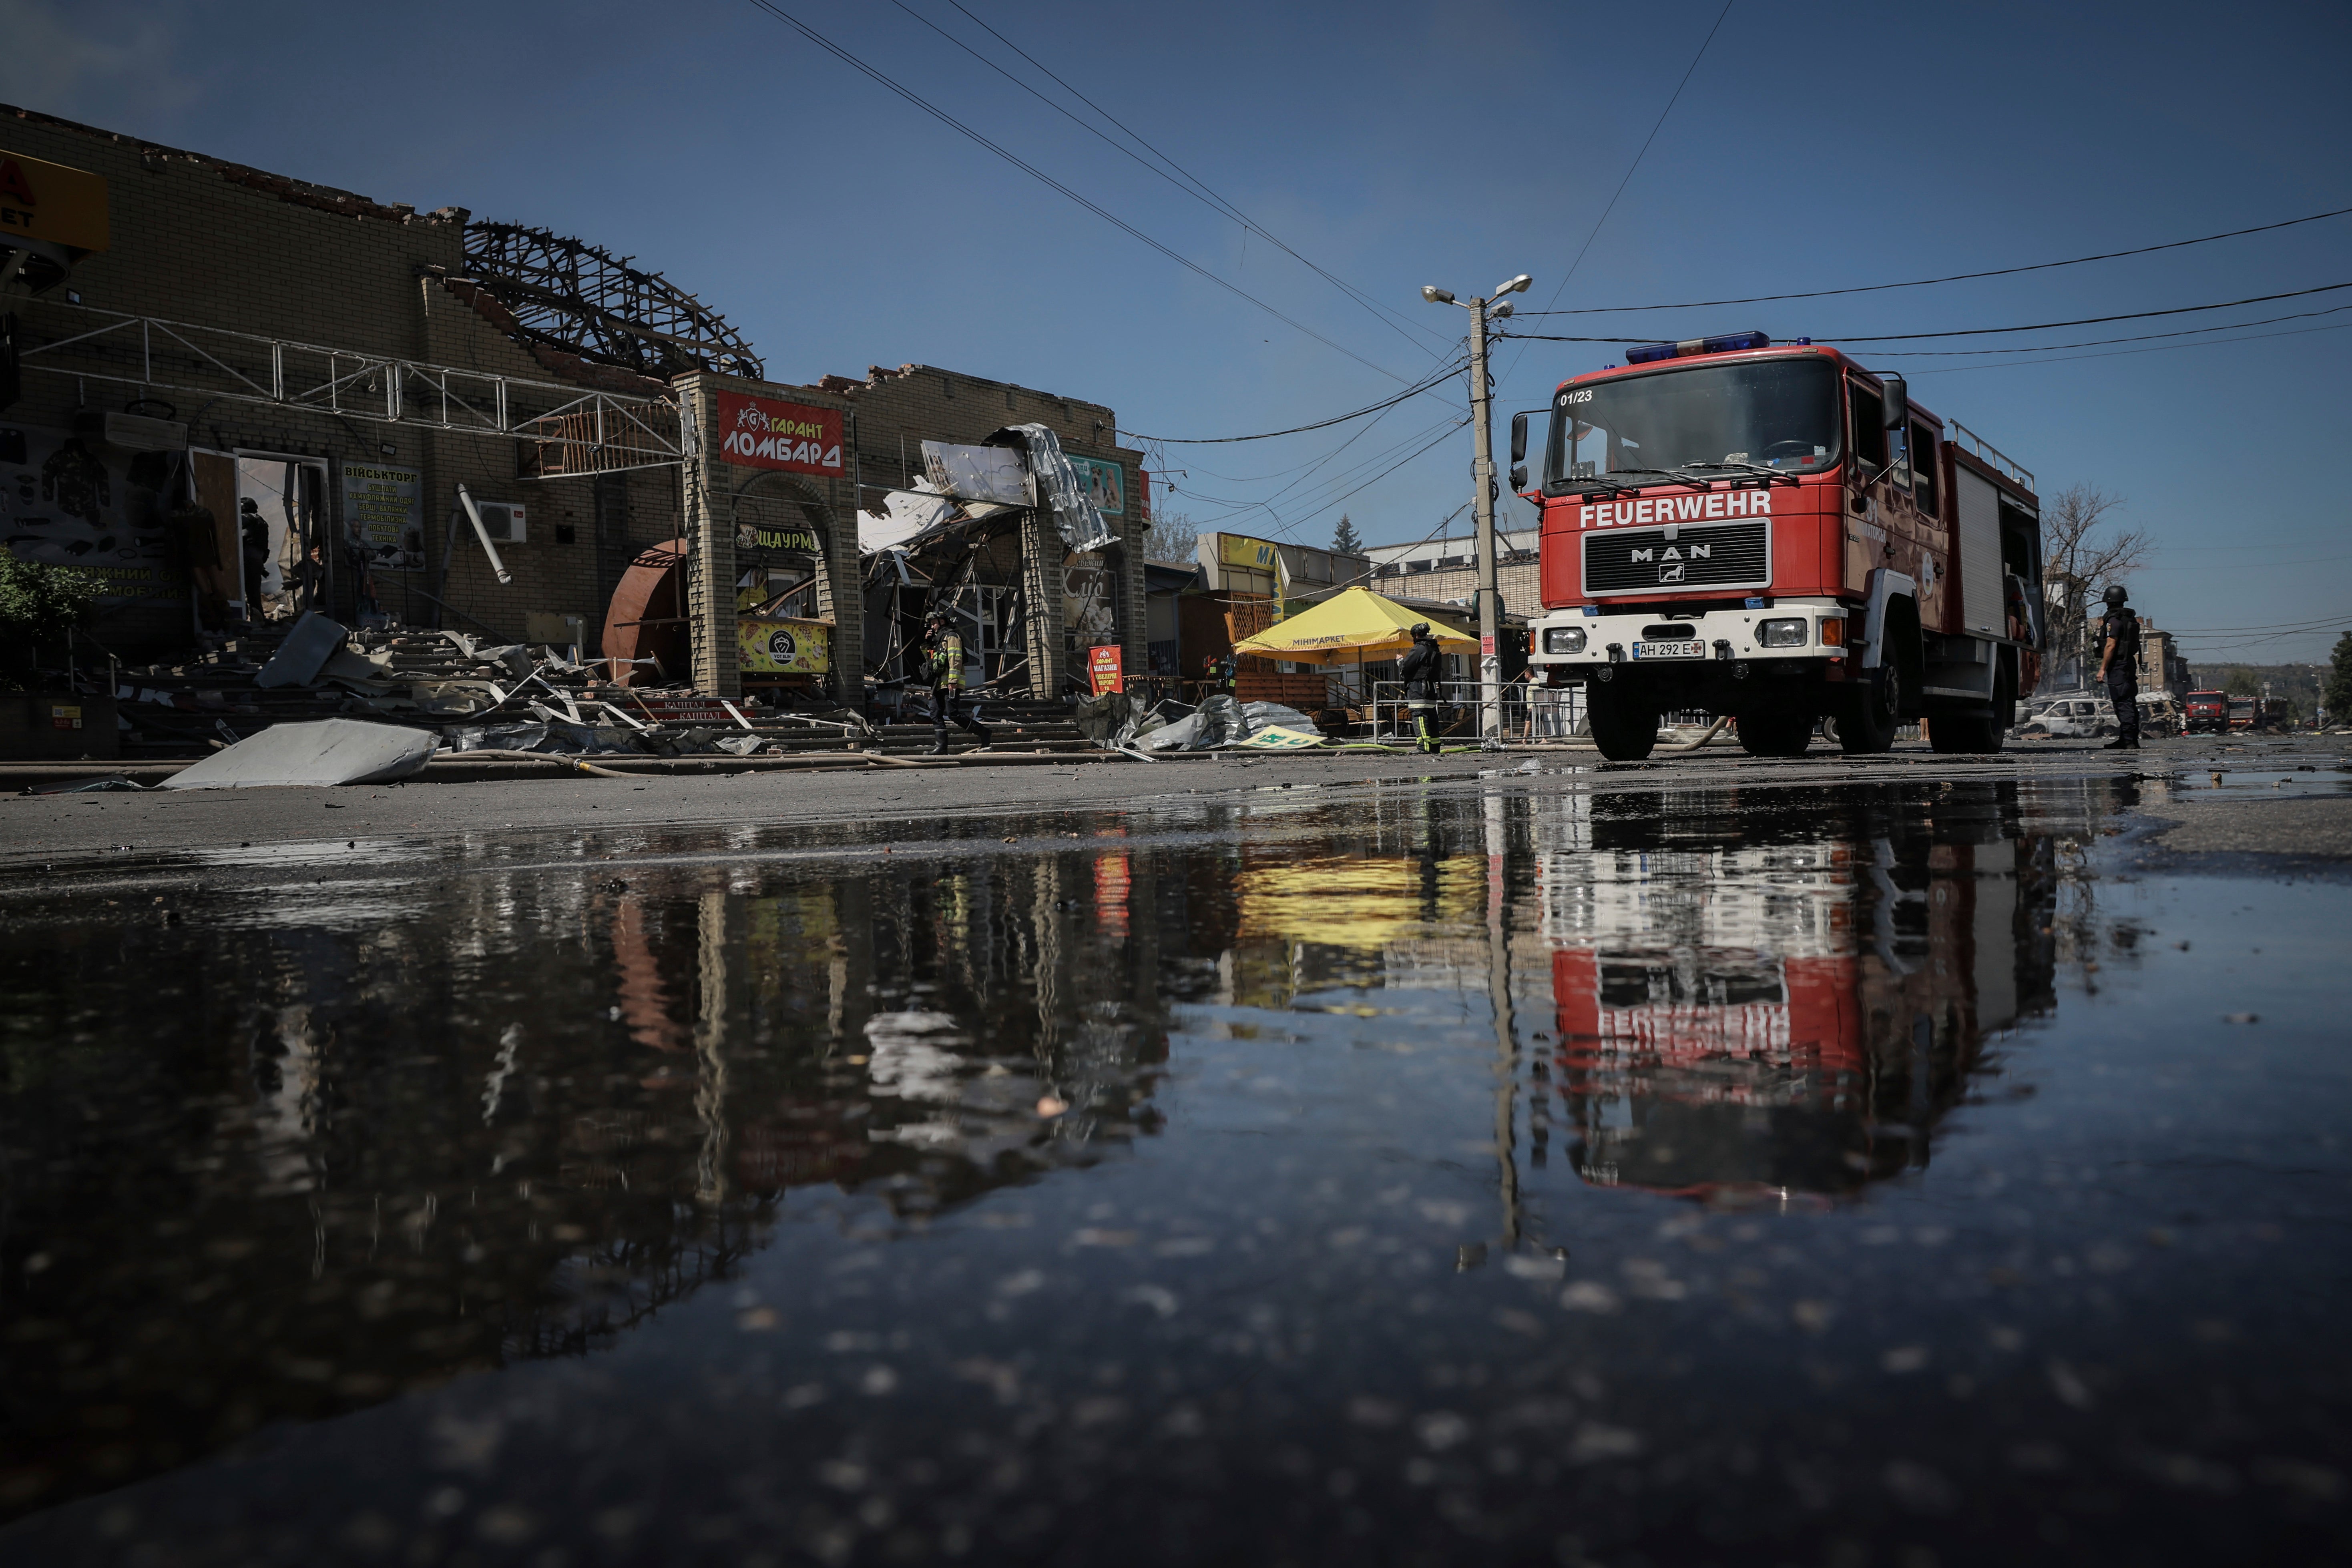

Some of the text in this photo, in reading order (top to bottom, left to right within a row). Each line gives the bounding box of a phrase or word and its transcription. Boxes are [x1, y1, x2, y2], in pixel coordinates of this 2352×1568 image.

[1561, 390, 1592, 406] 01/23
[771, 417, 823, 439] ГАРАНТ
[724, 430, 841, 468] ЛОМБАРД
[345, 466, 417, 483] ВІЙСЬКТОРГ
[368, 484, 397, 493] БУШЛАТИ
[349, 492, 414, 505] КАМУФЛЯЖНИЙ ОДЯГ
[380, 505, 408, 514] ВАЛЯНКИ
[1581, 491, 1771, 528] FEUERWEHR
[360, 514, 407, 524] ТЕРМОБІЛИЗНА
[368, 524, 399, 533] ПОБУТОВА
[1856, 520, 1886, 543] МАТОРСЬК
[372, 534, 397, 542] ТЕХНІКА
[1632, 544, 1711, 563] MAN
[1077, 554, 1104, 567] свіжий
[1292, 635, 1345, 646] МІНІМАРКЕТ
[1640, 644, 1690, 655] AH 292 E
